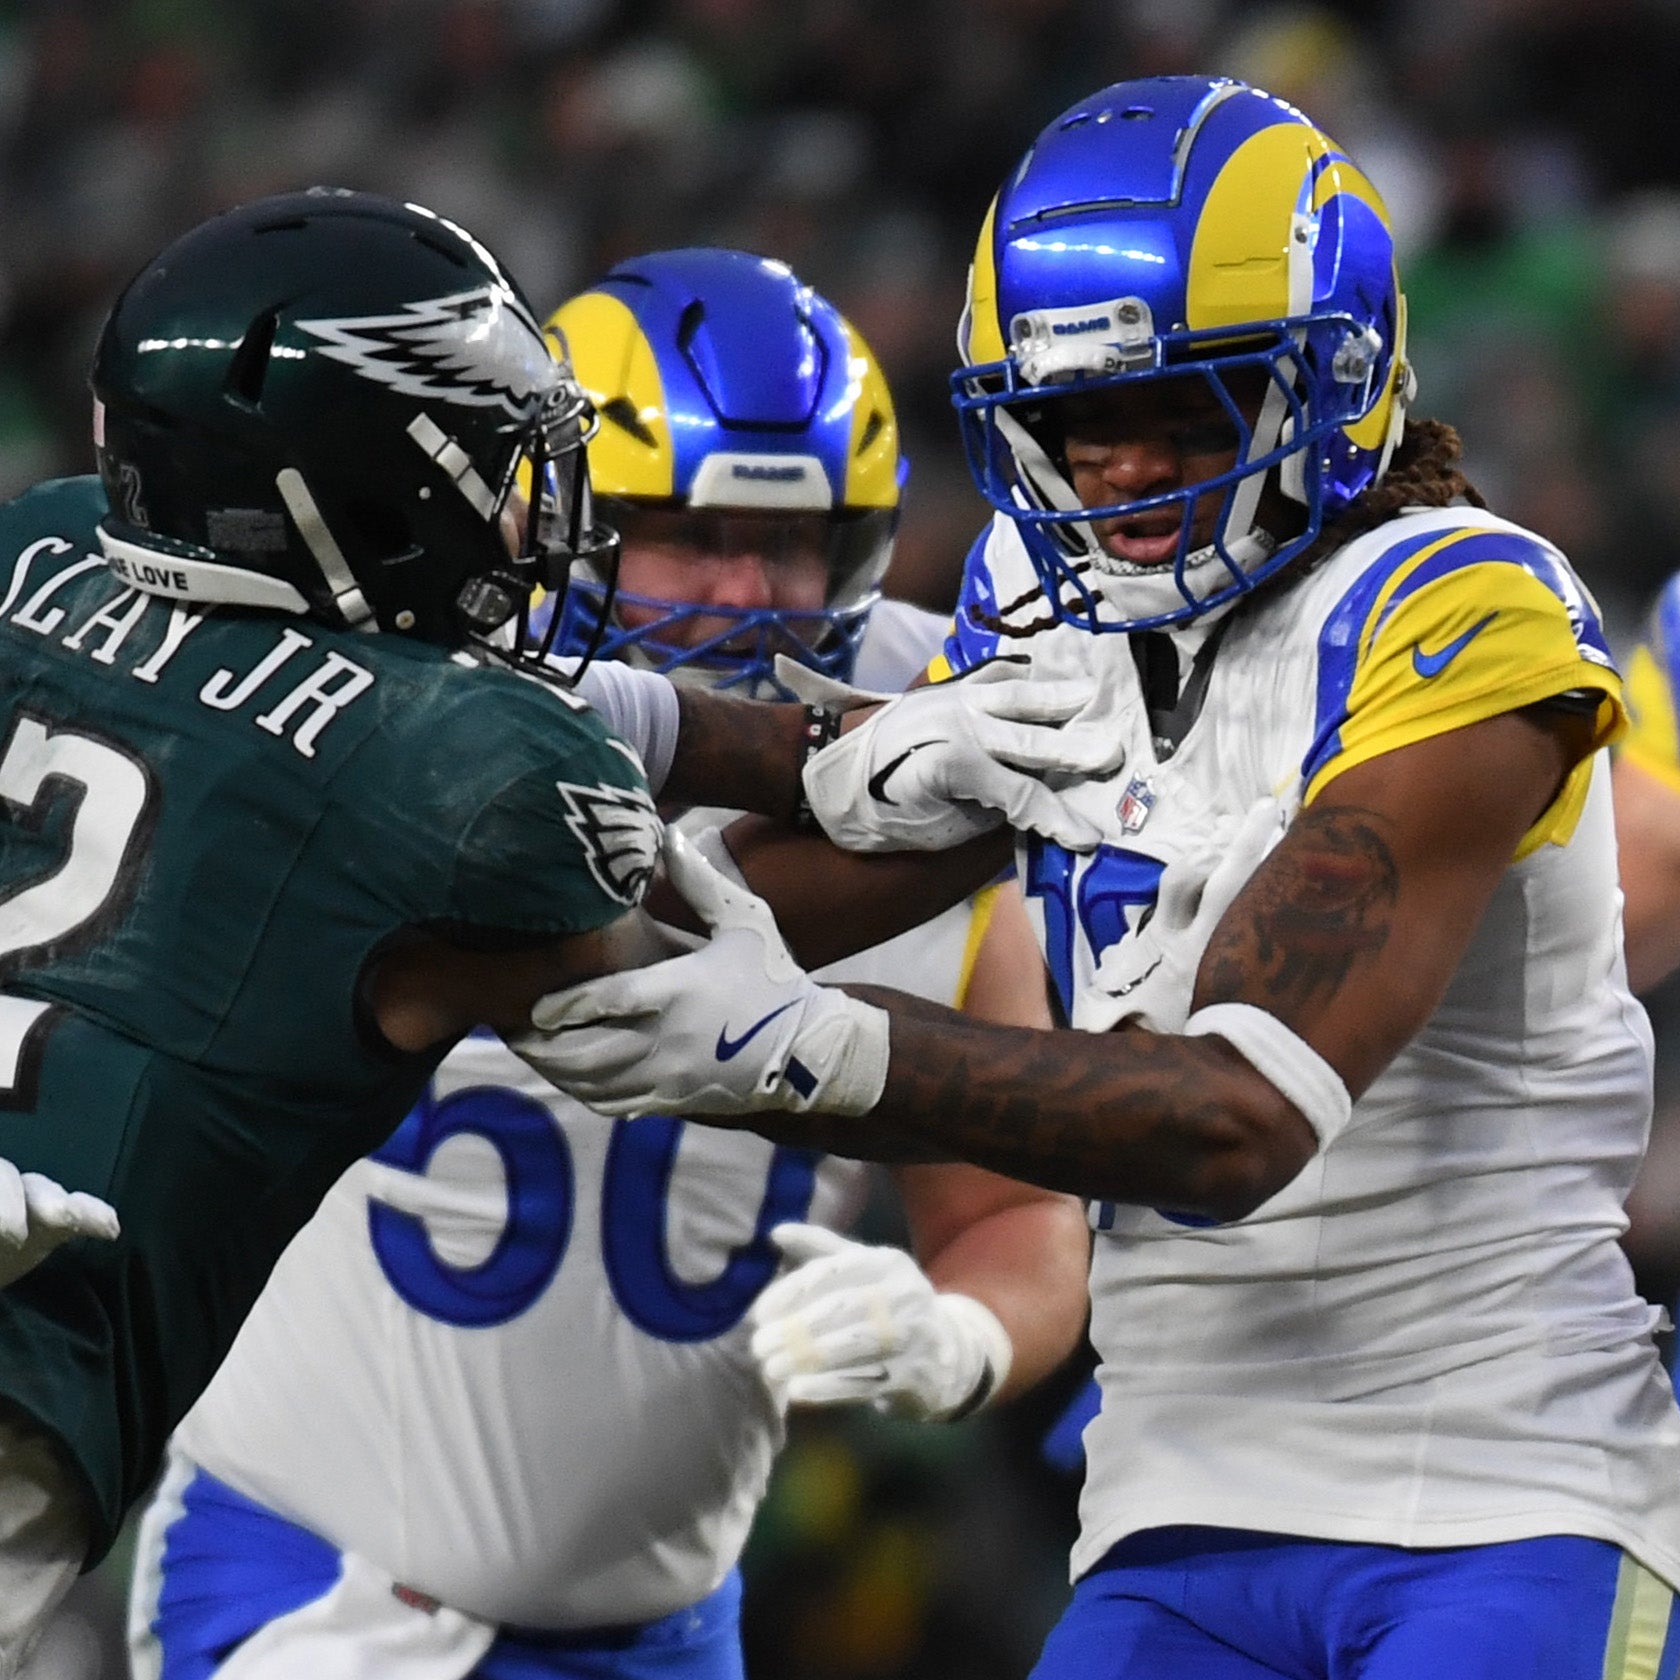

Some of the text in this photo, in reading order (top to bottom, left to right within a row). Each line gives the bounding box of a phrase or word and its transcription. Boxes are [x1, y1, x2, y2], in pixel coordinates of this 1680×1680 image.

[131, 561, 189, 591] LOVE
[199, 627, 375, 758] JR
[366, 1078, 818, 1344] 50
